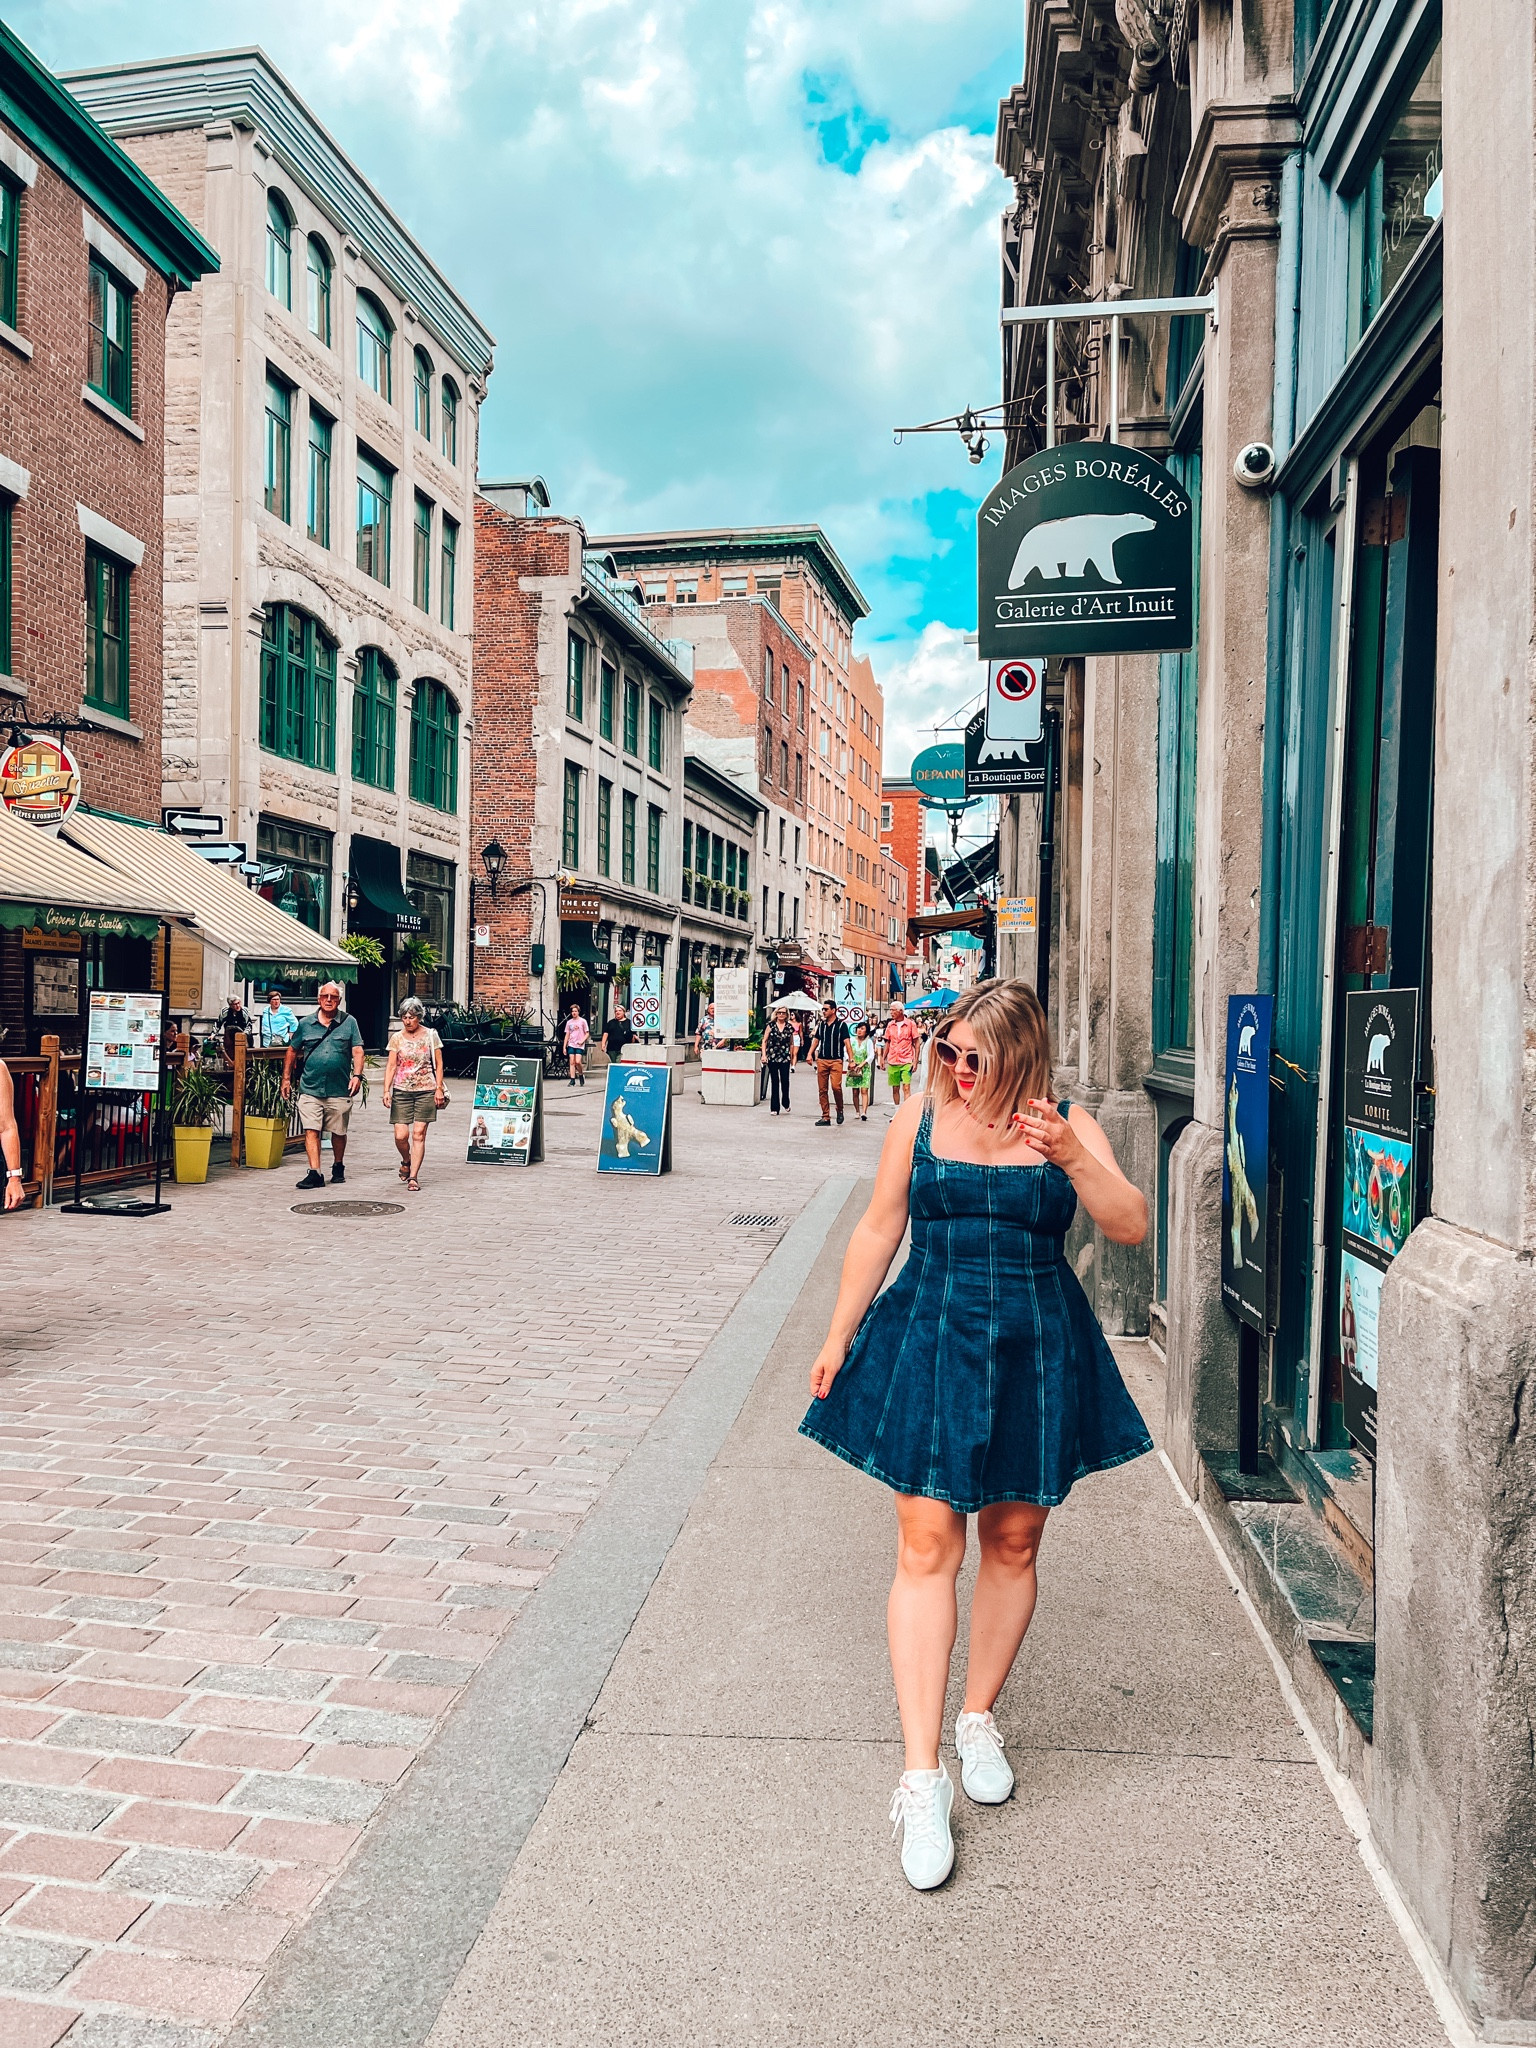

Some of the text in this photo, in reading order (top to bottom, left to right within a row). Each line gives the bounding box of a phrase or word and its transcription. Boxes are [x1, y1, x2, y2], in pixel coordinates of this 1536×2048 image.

[983, 460, 1188, 528] IMAGES BORÉALES
[996, 595, 1175, 619] Galerie d'Art Inuit
[966, 717, 986, 736] IMA
[12, 775, 60, 795] Suzette
[968, 770, 1045, 783] La Boutique Boré
[561, 899, 599, 908] THE KEG
[46, 908, 76, 926] Crêperie
[79, 911, 96, 928] Chez
[396, 913, 422, 925] THE KEG
[1364, 1104, 1390, 1121] KORITE
